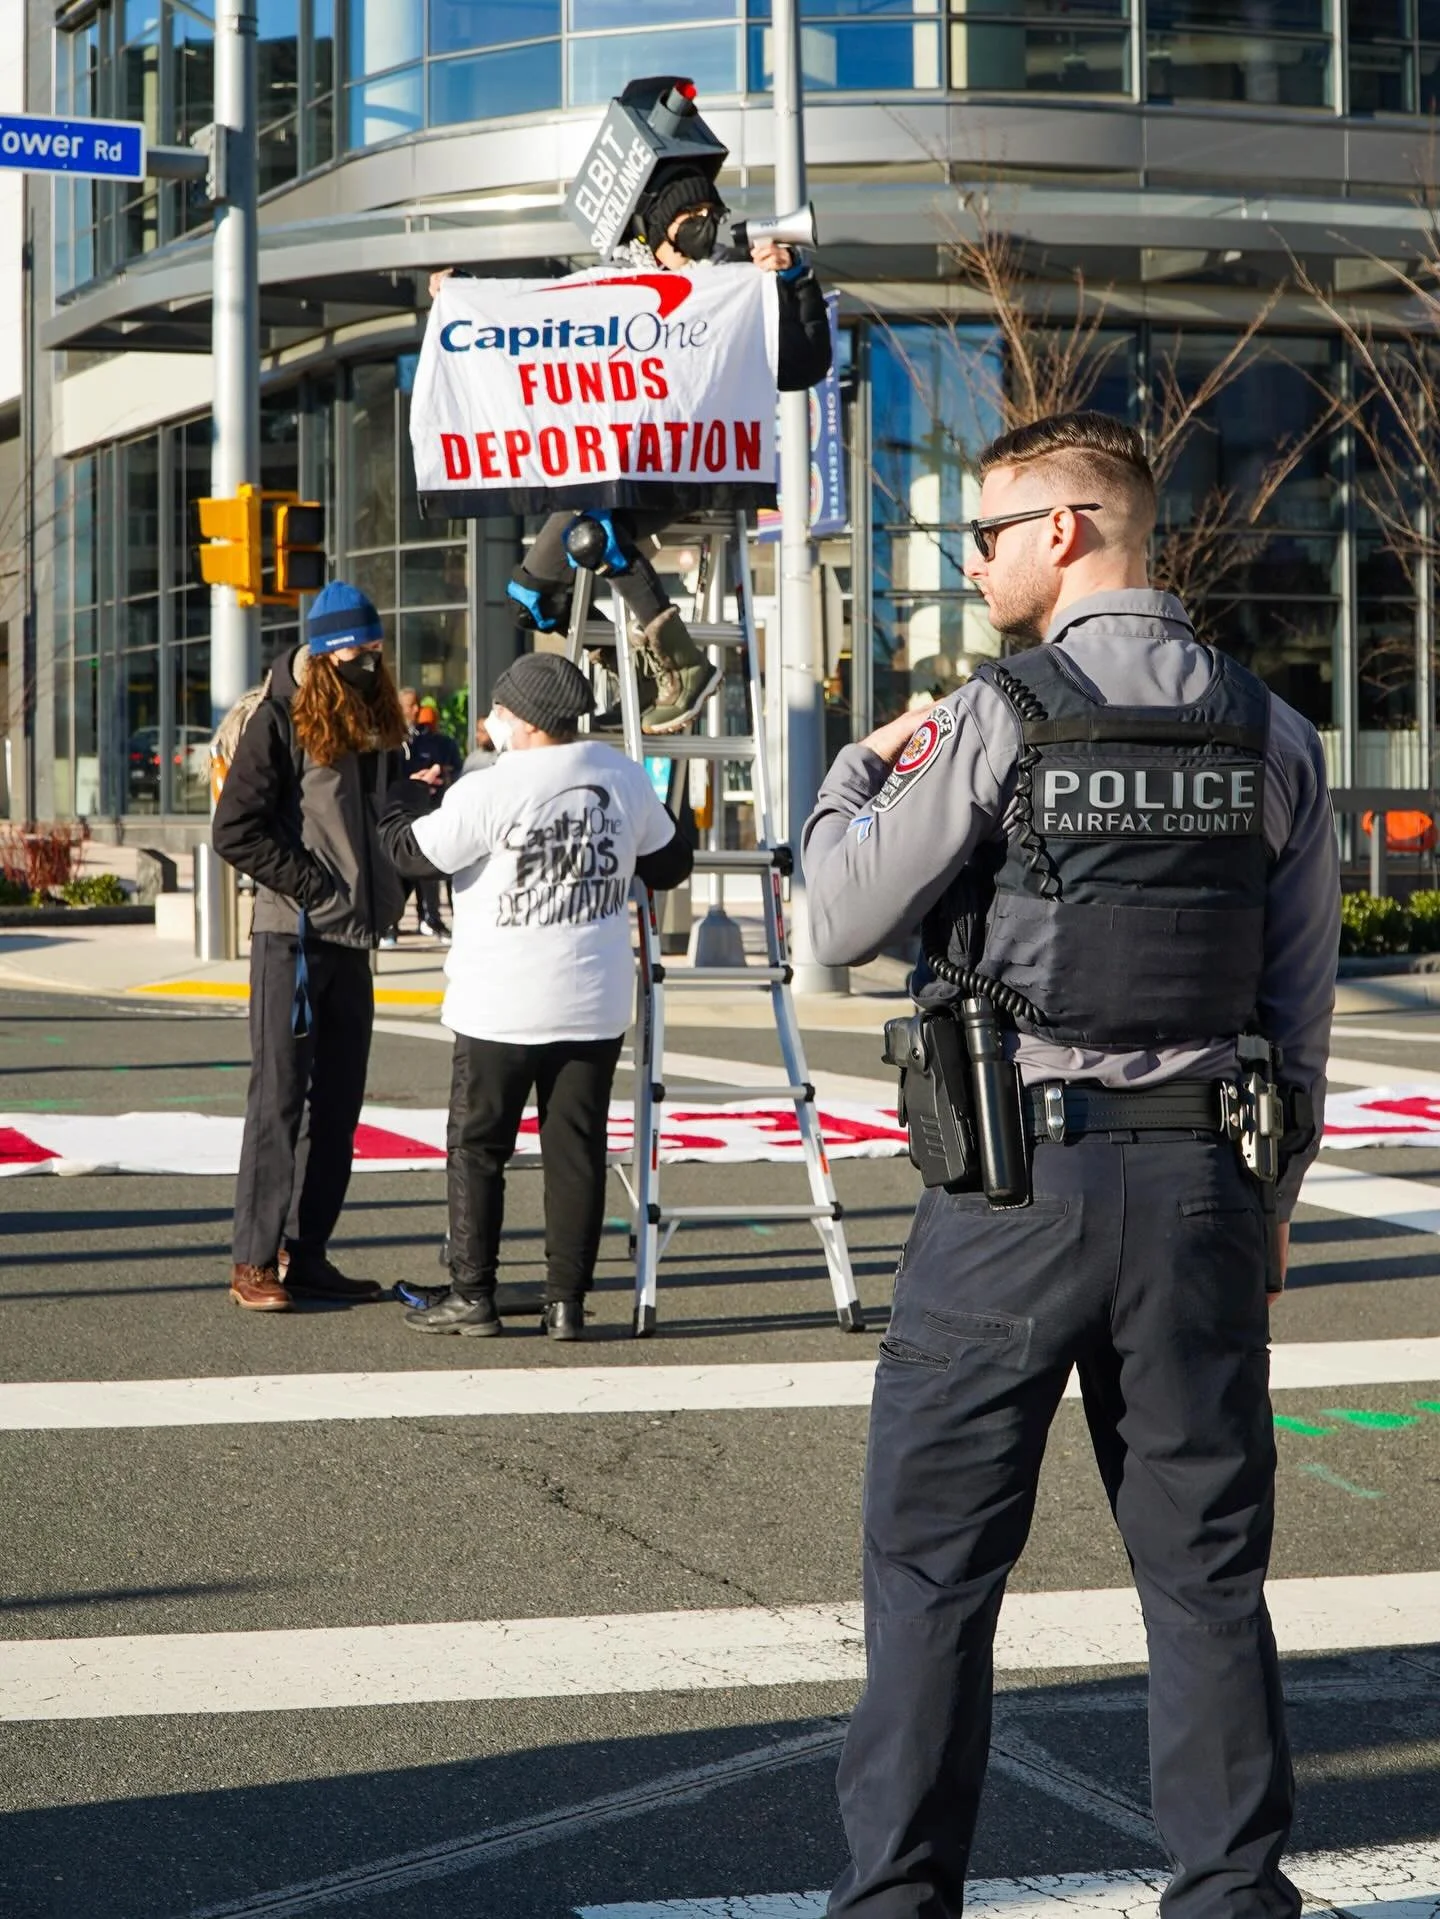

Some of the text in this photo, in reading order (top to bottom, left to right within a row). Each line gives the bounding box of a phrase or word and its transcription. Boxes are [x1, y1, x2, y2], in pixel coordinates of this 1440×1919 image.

[0, 126, 122, 162] ower Rd
[575, 124, 625, 225] ELBIT
[590, 137, 652, 256] SURVEILLANCE
[518, 357, 669, 406] FUNDS
[440, 420, 761, 481] DEPORTATION
[1044, 770, 1256, 810] POLICE
[1044, 812, 1254, 832] FAIRFAX COUNTY
[496, 876, 626, 928] DEPORTATION
